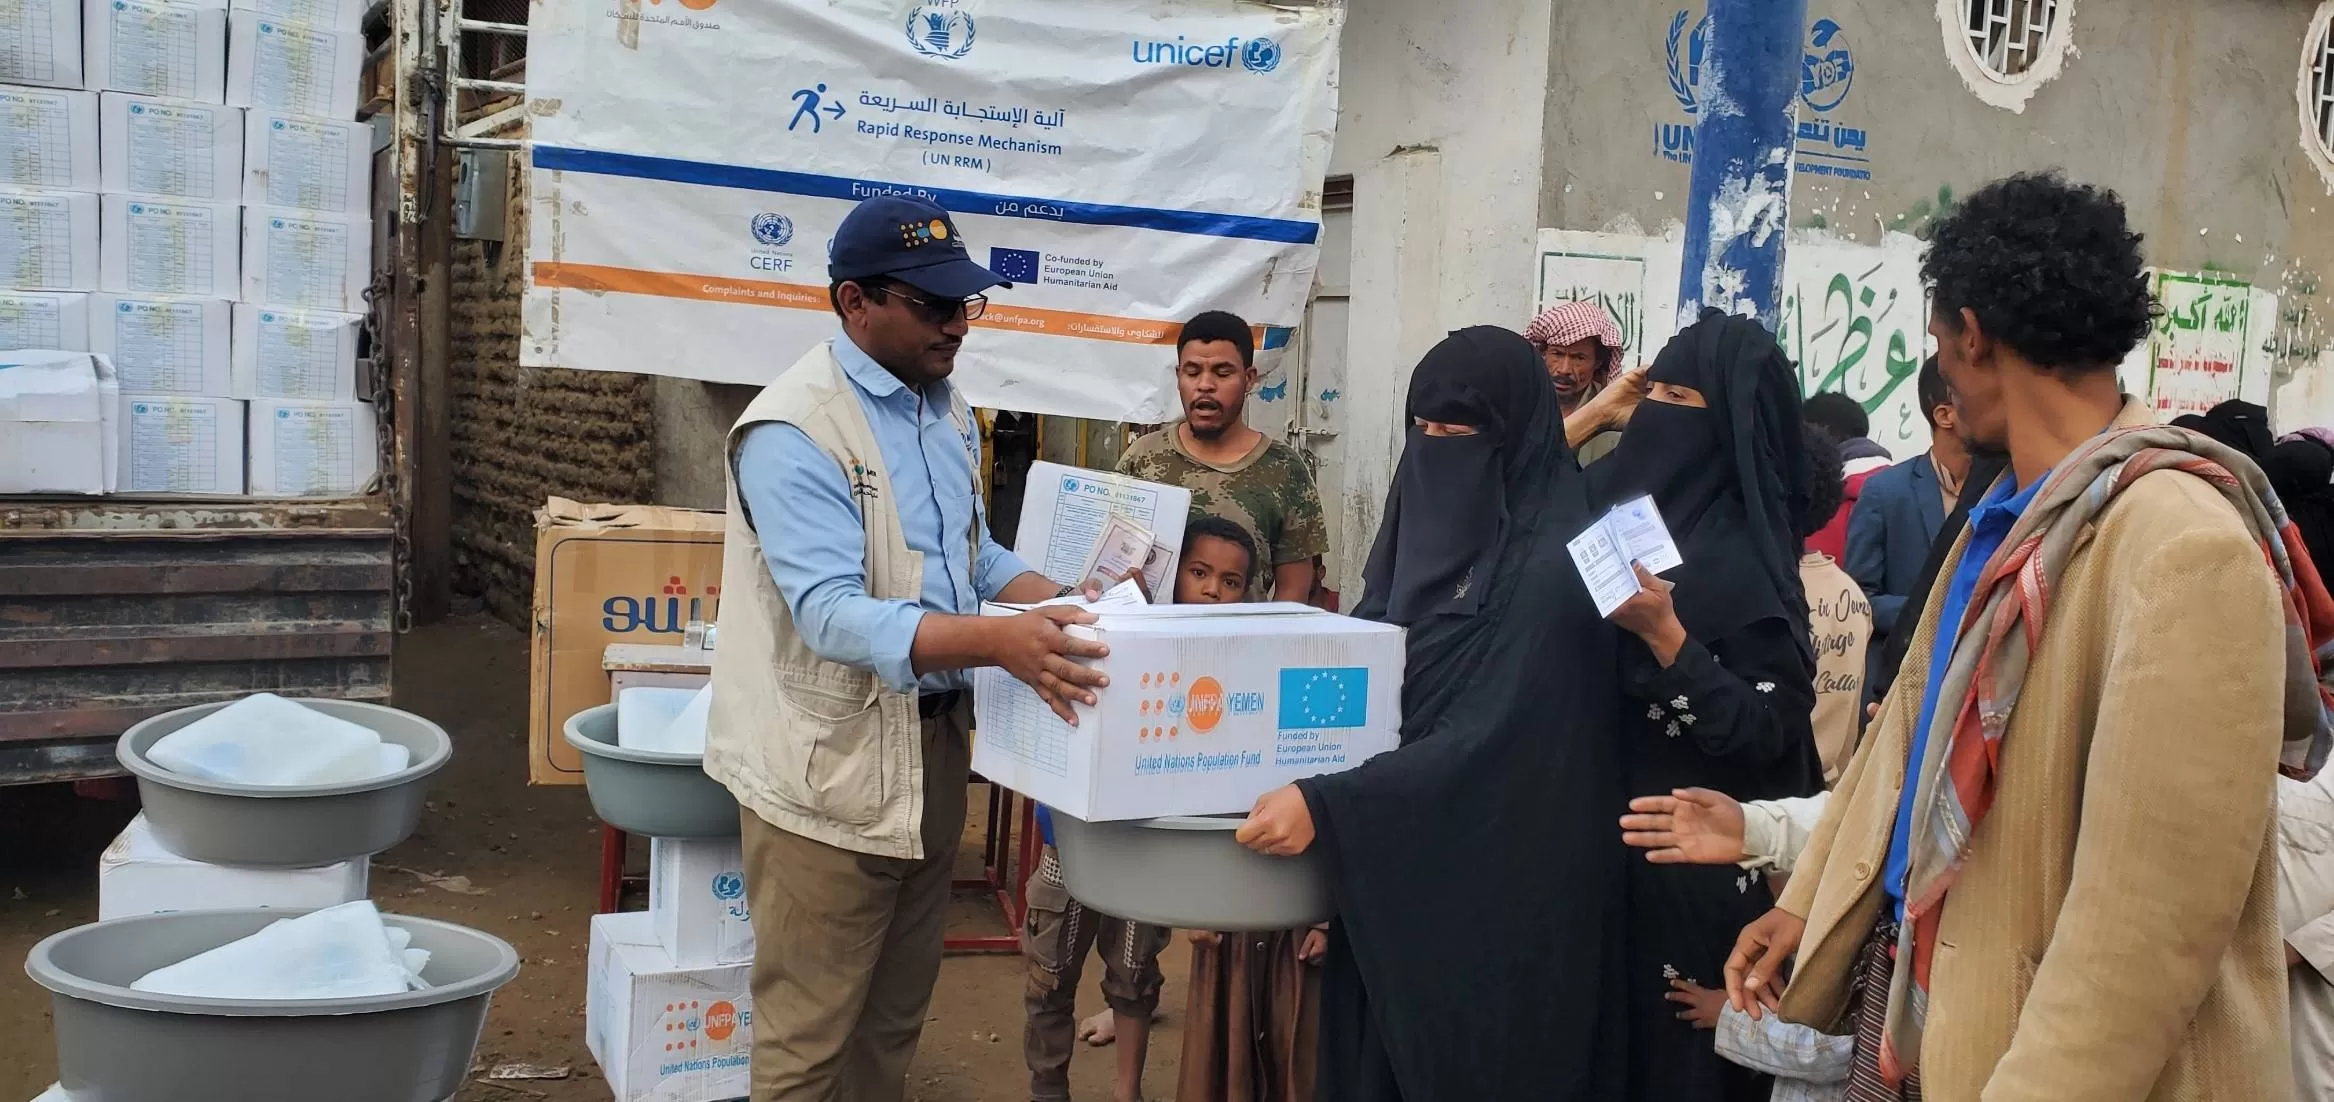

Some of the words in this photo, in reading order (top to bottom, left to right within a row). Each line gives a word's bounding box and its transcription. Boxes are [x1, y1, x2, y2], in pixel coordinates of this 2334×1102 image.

[1133, 35, 1239, 68] unicef
[1034, 109, 1065, 130] آلية
[857, 120, 899, 139] Rapid
[904, 125, 974, 145] Response
[978, 134, 1062, 155] Mechanism
[1663, 124, 1695, 151] UN
[954, 156, 983, 169] RRM
[995, 201, 1019, 215] من
[1024, 204, 1064, 220] بدعم
[750, 256, 793, 272] CERF
[1045, 253, 1091, 266] Co-funded
[1093, 258, 1104, 269] by
[1044, 265, 1086, 276] European
[1089, 269, 1114, 279] Union
[703, 284, 755, 297] Complaints
[758, 290, 775, 299] and
[1043, 276, 1101, 289] Humanitarian
[1103, 282, 1118, 291] Aid
[1084, 484, 1096, 494] PO
[1227, 692, 1264, 712] YEMEN
[1278, 731, 1308, 741] Funded
[1309, 731, 1320, 741] by
[1276, 744, 1316, 754] European
[1318, 742, 1342, 752] Union
[1135, 753, 1163, 771] United
[1164, 753, 1195, 770] Nations
[1197, 752, 1239, 769] Population
[1240, 750, 1262, 766] Fund
[1275, 755, 1331, 766] Humanitarian
[1331, 753, 1346, 763] Aid
[738, 1011, 752, 1027] YE
[660, 1060, 682, 1076] United
[685, 1059, 710, 1071] Nations
[712, 1055, 750, 1070] Population
